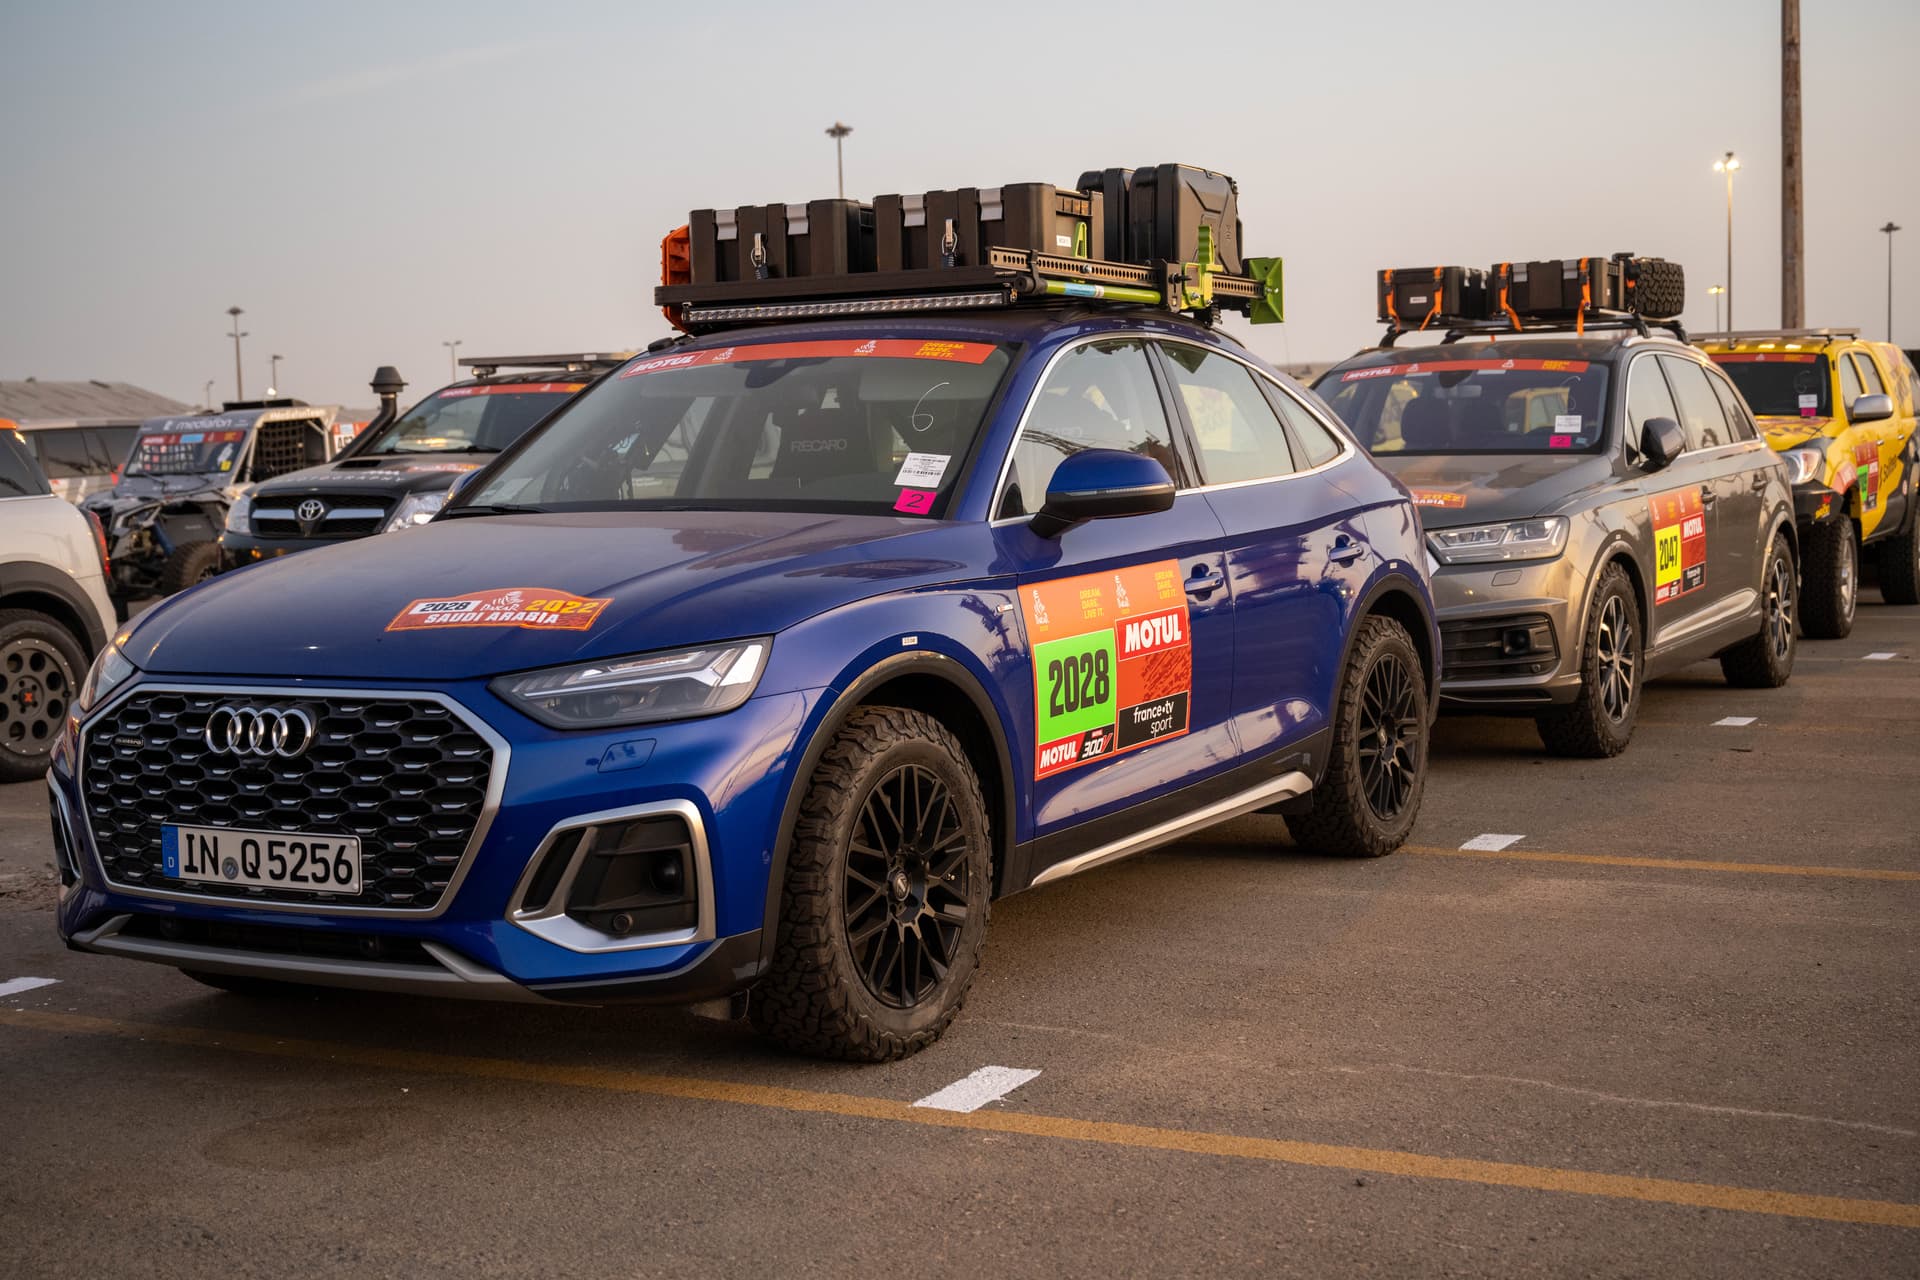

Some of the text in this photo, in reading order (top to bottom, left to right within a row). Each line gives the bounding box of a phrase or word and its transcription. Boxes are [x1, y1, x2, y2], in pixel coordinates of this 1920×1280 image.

[629, 355, 695, 374] MOTUL
[1346, 368, 1391, 379] MOTUL
[911, 382, 950, 432] 6
[791, 438, 848, 452] RECARO
[906, 493, 925, 508] 2
[1683, 517, 1703, 539] MOTUL
[1659, 535, 1678, 571] 2047
[420, 601, 472, 612] 2028
[524, 599, 600, 614] 2022
[424, 611, 560, 624] SAUDI ARABIA
[1125, 613, 1182, 653] MOTUL
[1048, 648, 1110, 718] 2028
[1150, 715, 1173, 739] sport
[1040, 740, 1078, 769] MOTUL
[1082, 732, 1113, 759] 300V
[167, 856, 175, 868] D
[184, 833, 219, 876] IN
[267, 840, 354, 885] 5256
